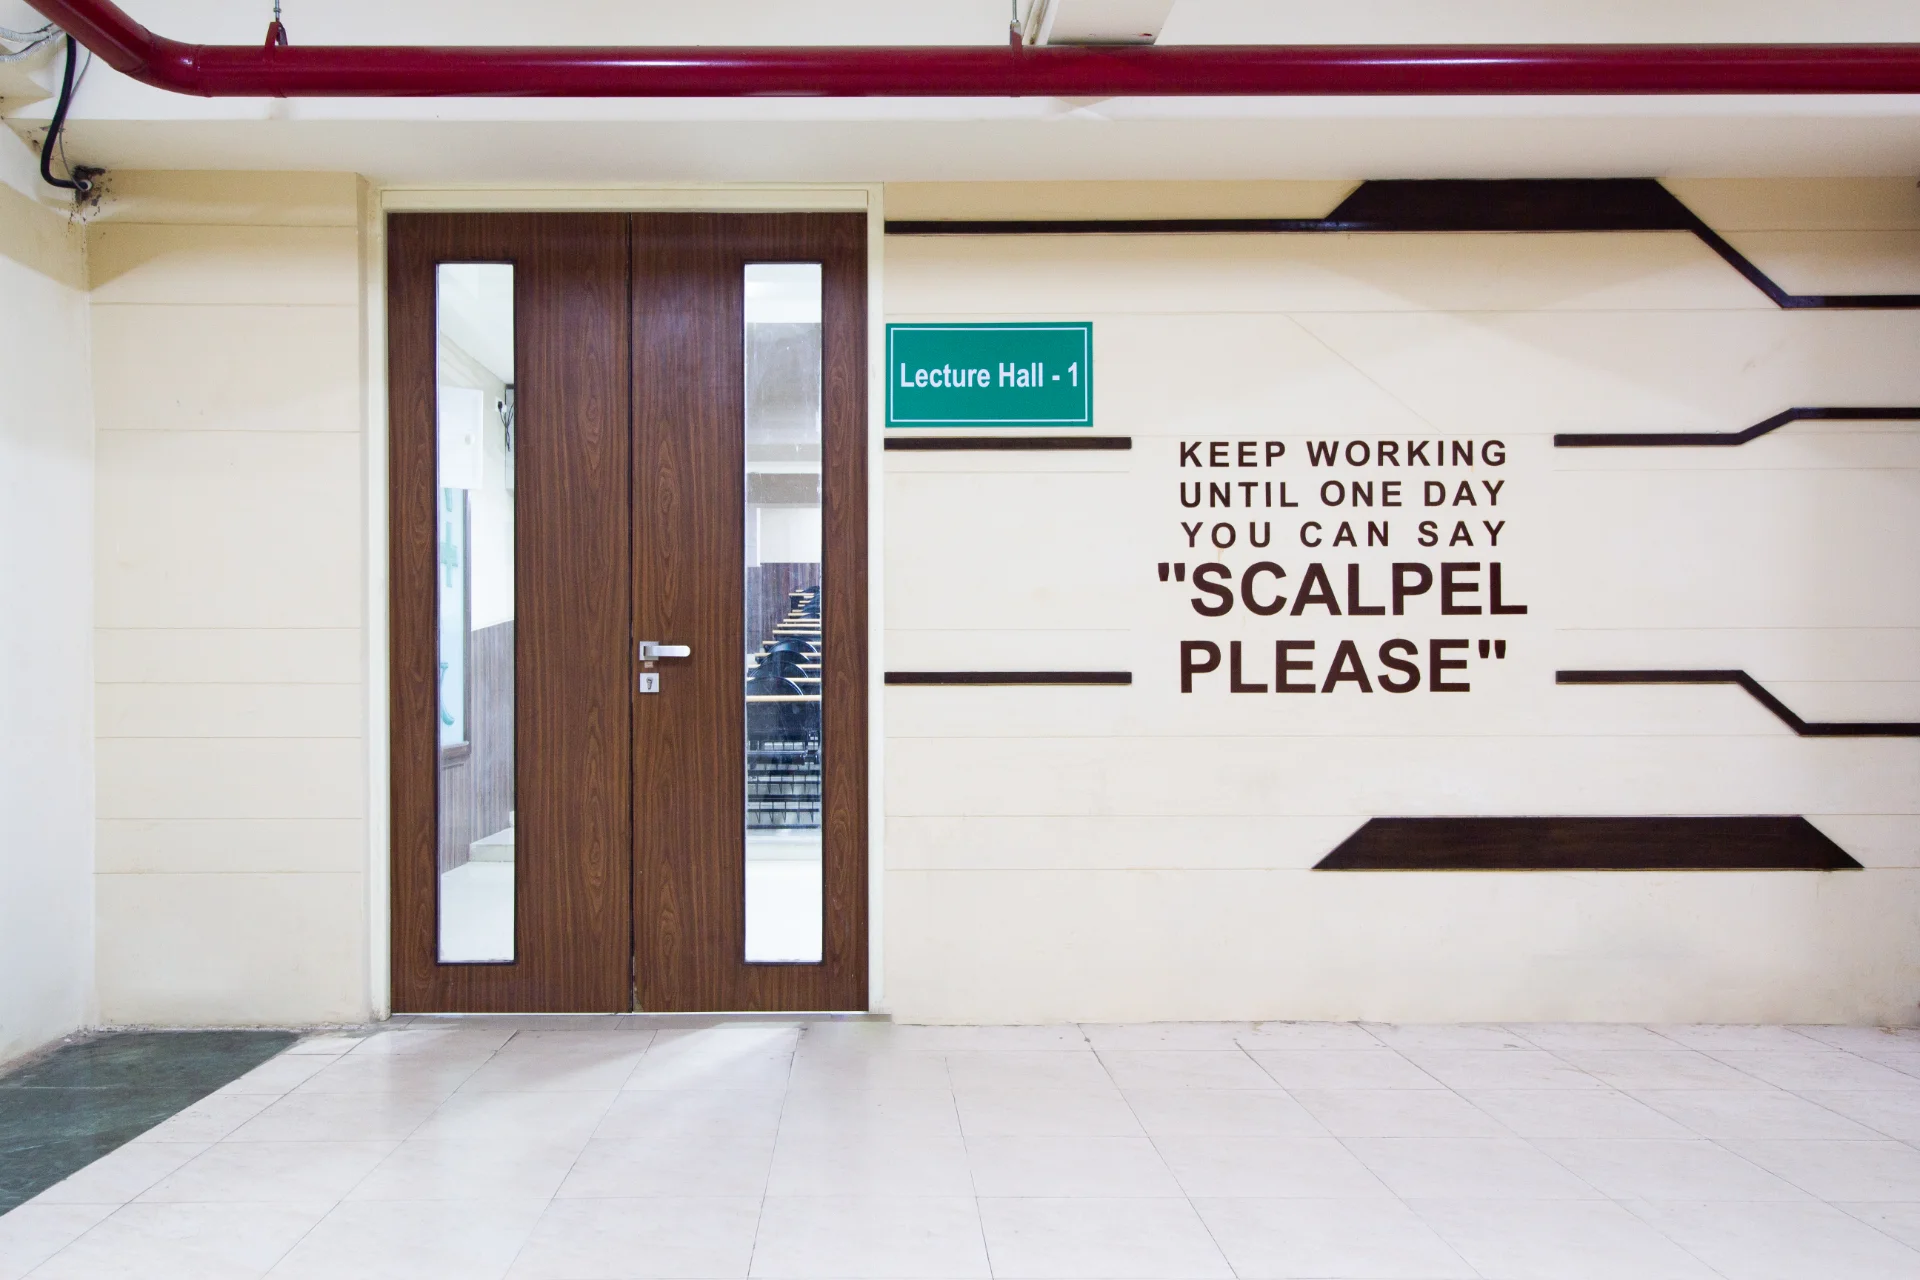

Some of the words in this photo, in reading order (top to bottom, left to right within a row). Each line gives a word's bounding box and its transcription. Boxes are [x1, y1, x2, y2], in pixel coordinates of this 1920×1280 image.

[900, 362, 991, 388] Lecture
[999, 362, 1044, 388] Hall
[1068, 361, 1077, 388] 1
[1180, 441, 1286, 468] KEEP
[1306, 439, 1506, 468] WORKING
[1180, 481, 1299, 508] UNTIL
[1320, 480, 1402, 508] ONE
[1424, 480, 1505, 507] DAY
[1181, 521, 1271, 549] YOU
[1300, 520, 1389, 549] CAN
[1417, 520, 1506, 548] SAY
[1157, 561, 1528, 617] "SCALPEL
[1180, 638, 1507, 694] PLEASE"
